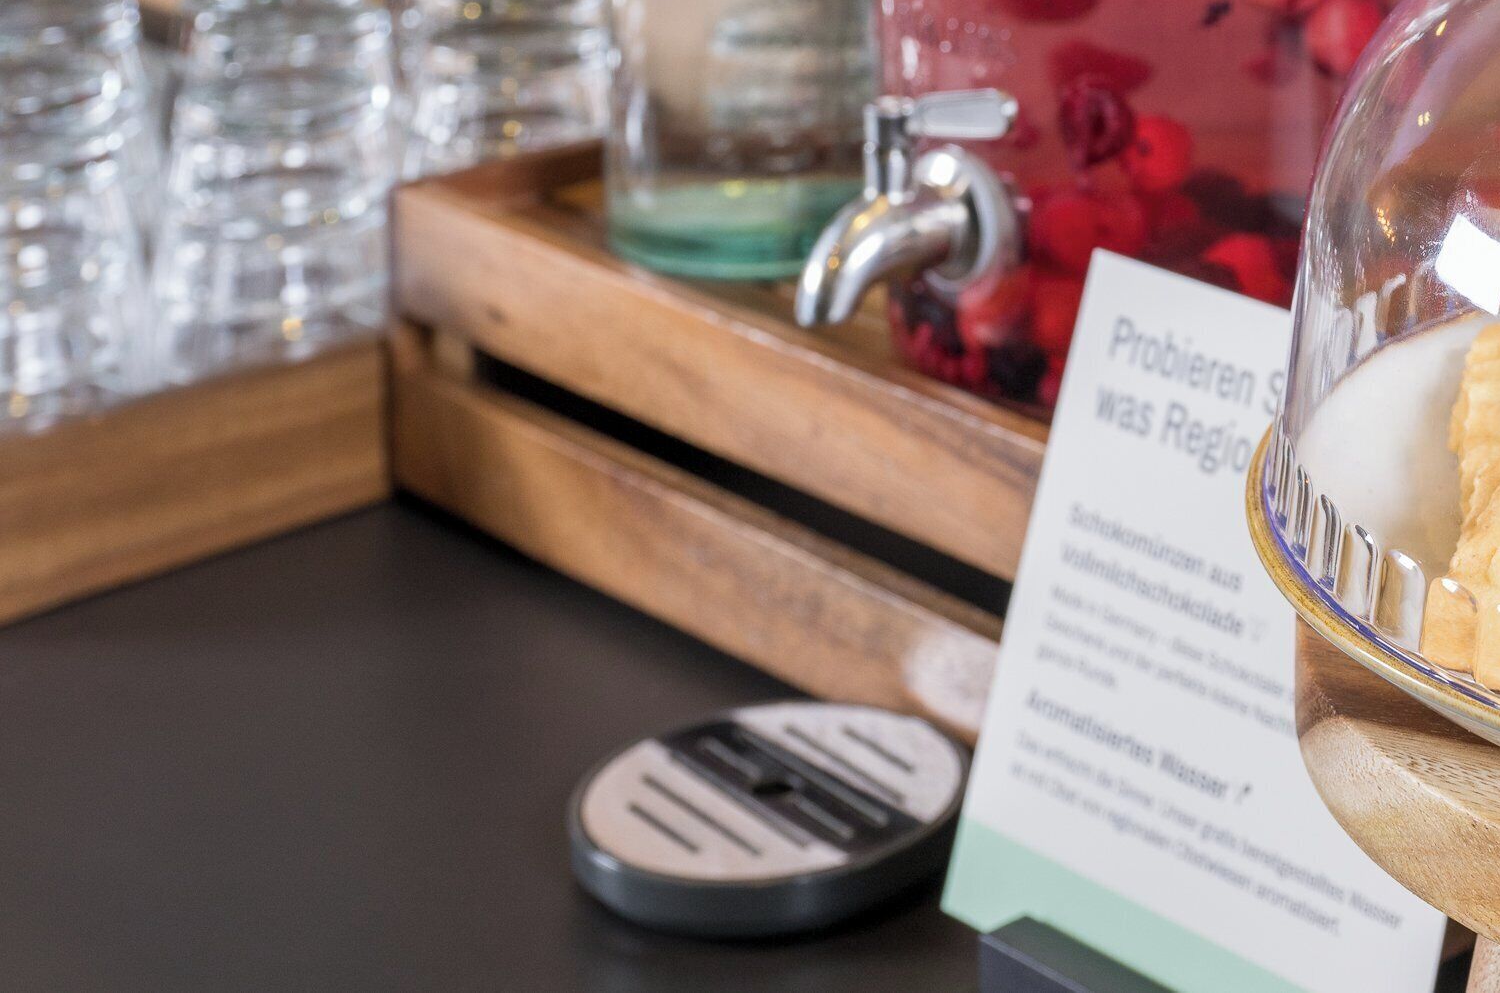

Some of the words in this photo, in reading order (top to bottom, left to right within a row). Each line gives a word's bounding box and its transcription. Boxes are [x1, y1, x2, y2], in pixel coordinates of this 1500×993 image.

[1108, 314, 1256, 406] Probieren
[1095, 383, 1154, 439] was
[1159, 398, 1253, 476] Regio
[1208, 563, 1245, 594] aus
[1158, 748, 1229, 801] Wasser
